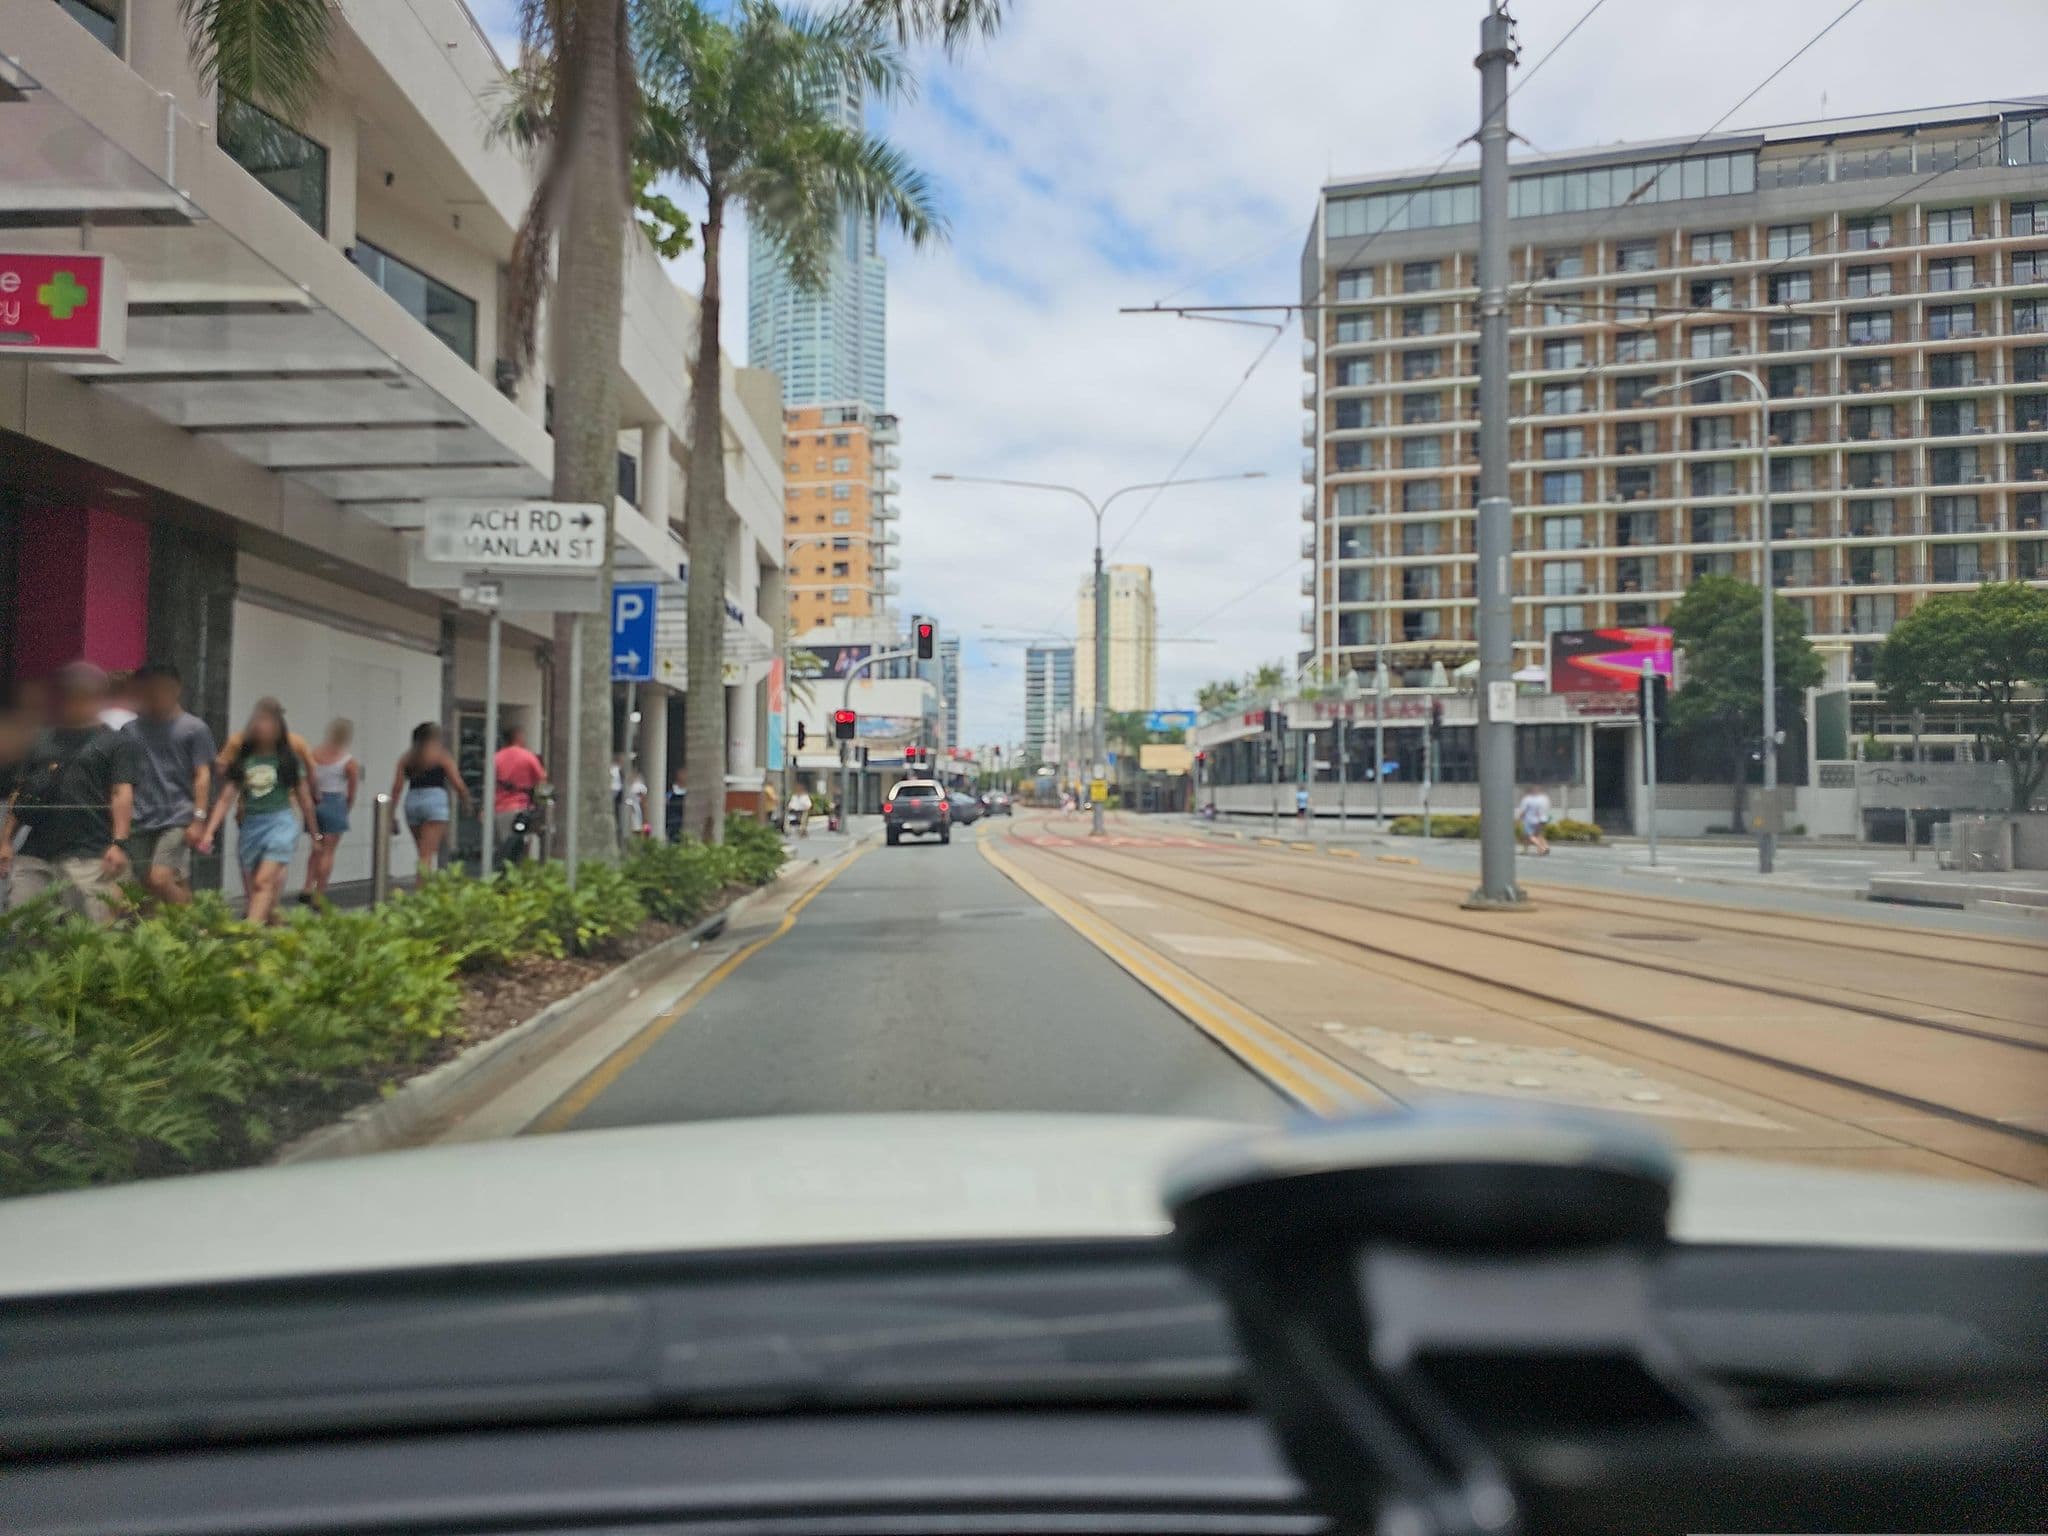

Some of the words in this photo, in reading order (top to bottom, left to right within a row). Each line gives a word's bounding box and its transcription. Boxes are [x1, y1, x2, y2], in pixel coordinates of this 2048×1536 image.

[453, 509, 519, 531] ACH
[530, 510, 562, 532] RD
[568, 538, 595, 559] ST
[615, 593, 645, 634] P
